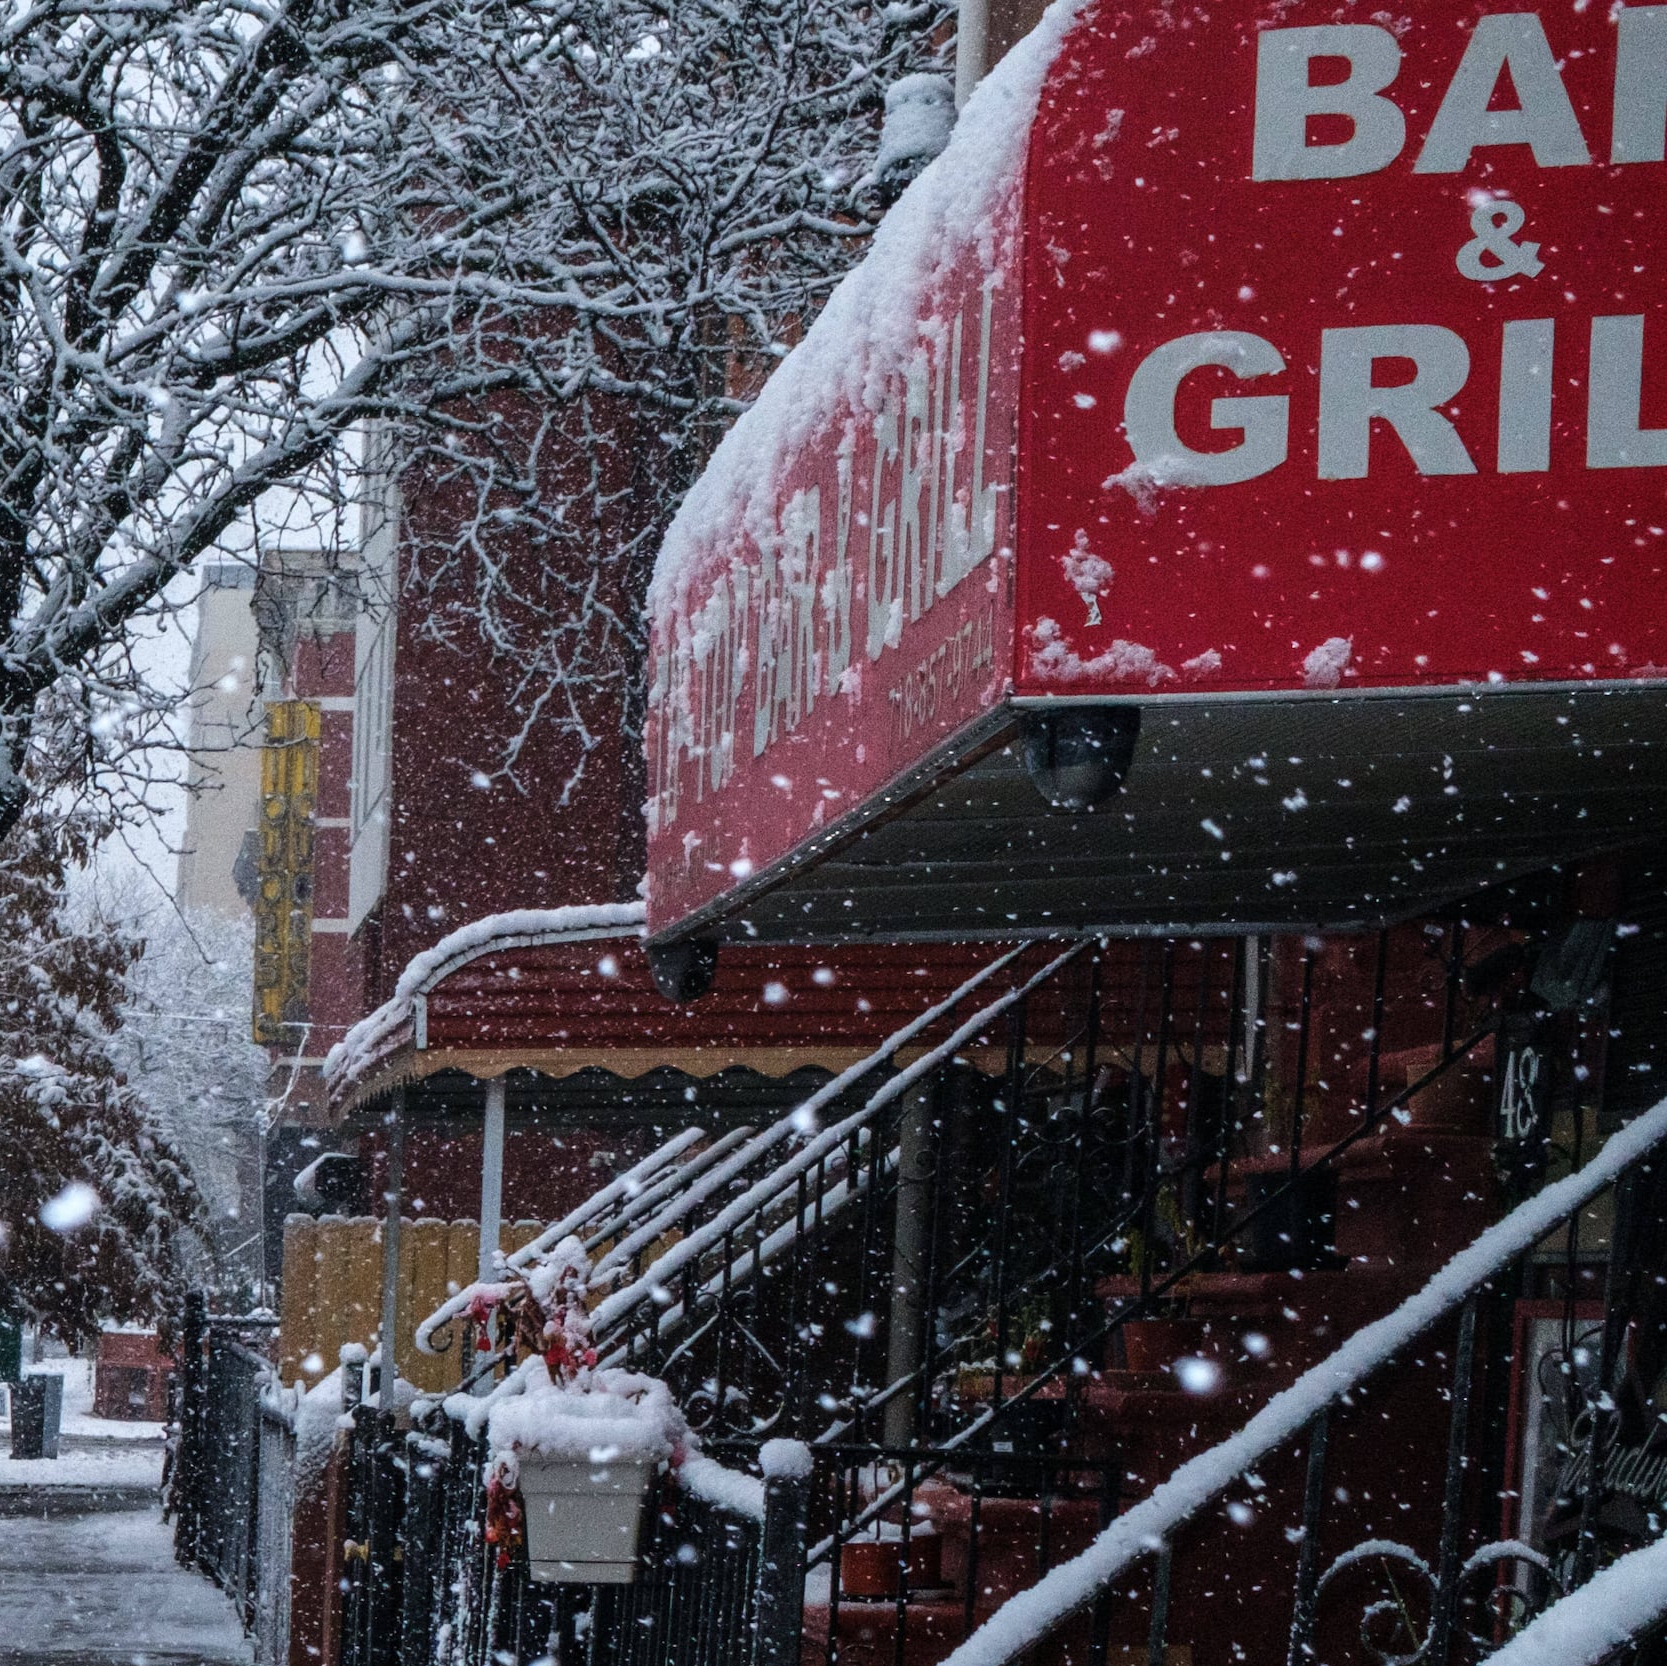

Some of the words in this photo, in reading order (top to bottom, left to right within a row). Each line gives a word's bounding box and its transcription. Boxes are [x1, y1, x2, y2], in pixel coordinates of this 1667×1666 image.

[1455, 200, 1545, 281] &
[1123, 313, 1667, 488] GRIL
[754, 484, 819, 757] BAR
[867, 286, 997, 662] GRILL
